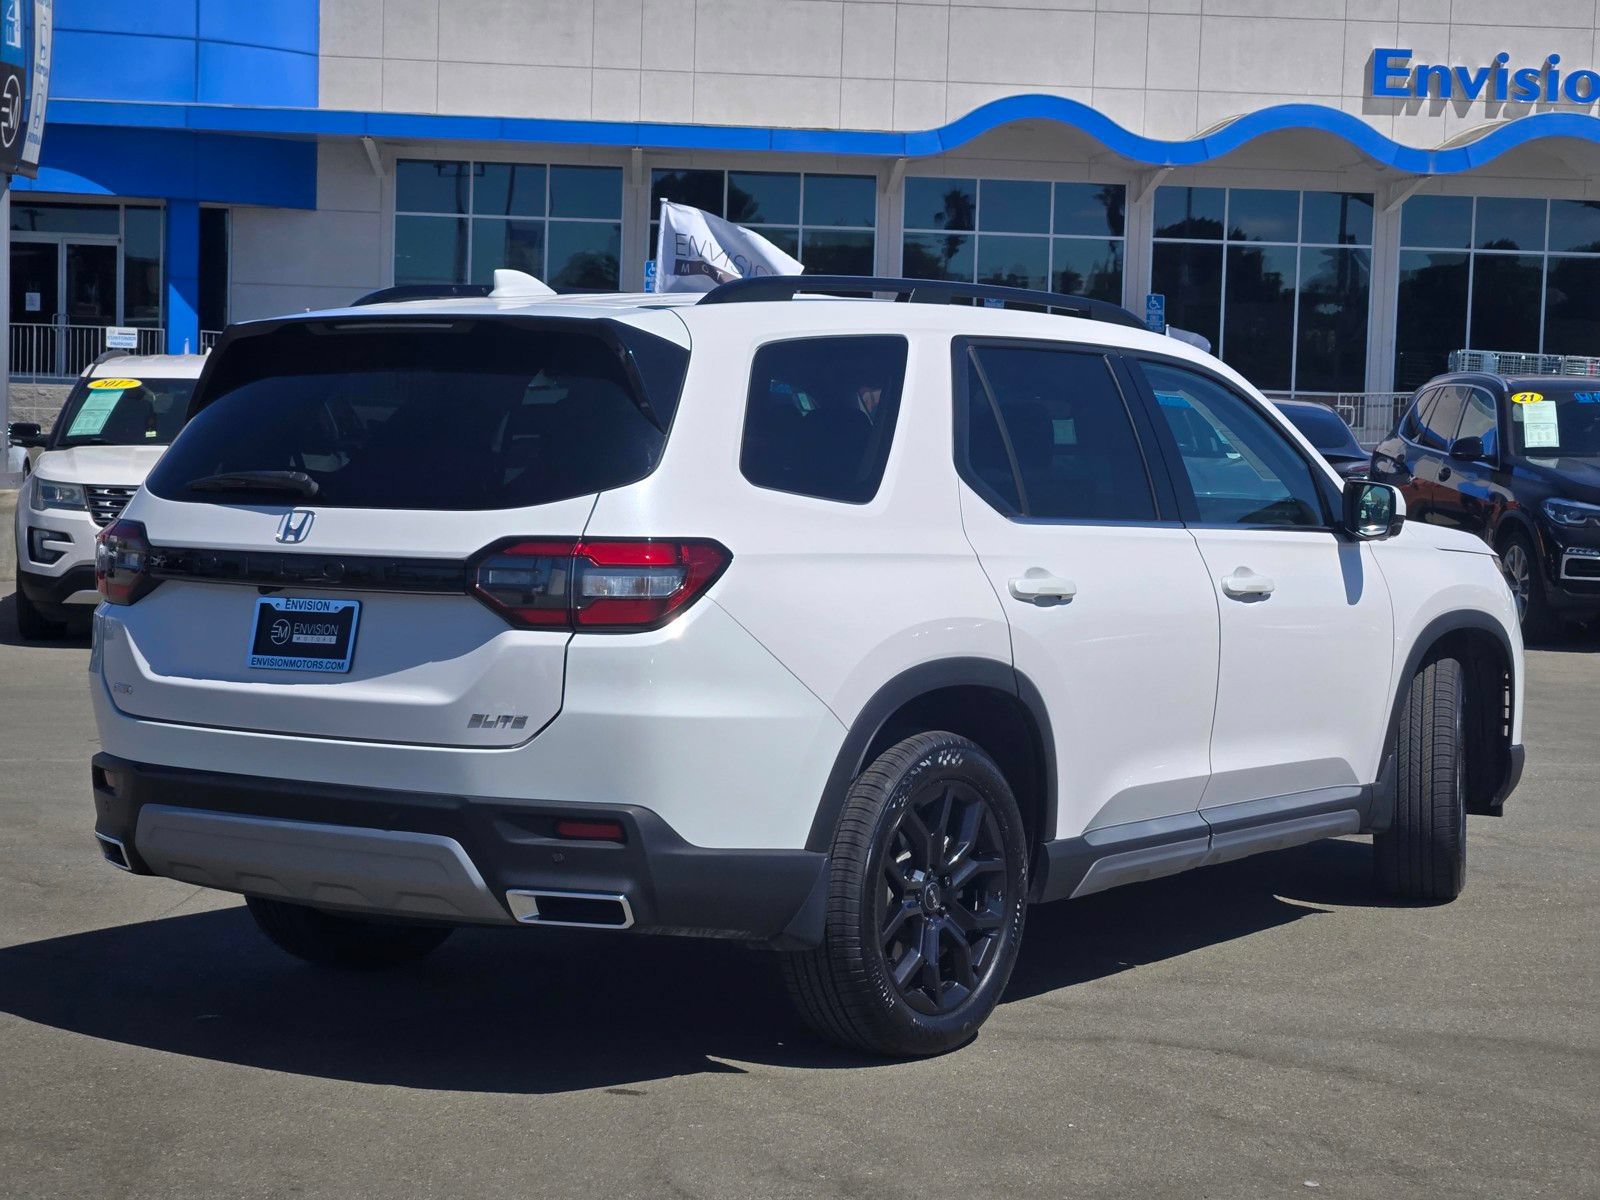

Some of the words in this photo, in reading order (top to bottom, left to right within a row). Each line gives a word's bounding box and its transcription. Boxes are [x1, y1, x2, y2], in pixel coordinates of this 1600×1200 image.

[1372, 48, 1600, 104] Envisio
[1519, 394, 1535, 402] 21
[285, 599, 331, 612] ENVISION
[293, 622, 339, 635] ENVISION
[250, 656, 345, 671] ENVISIONMOTORS.COM
[467, 713, 528, 729] ELITE
